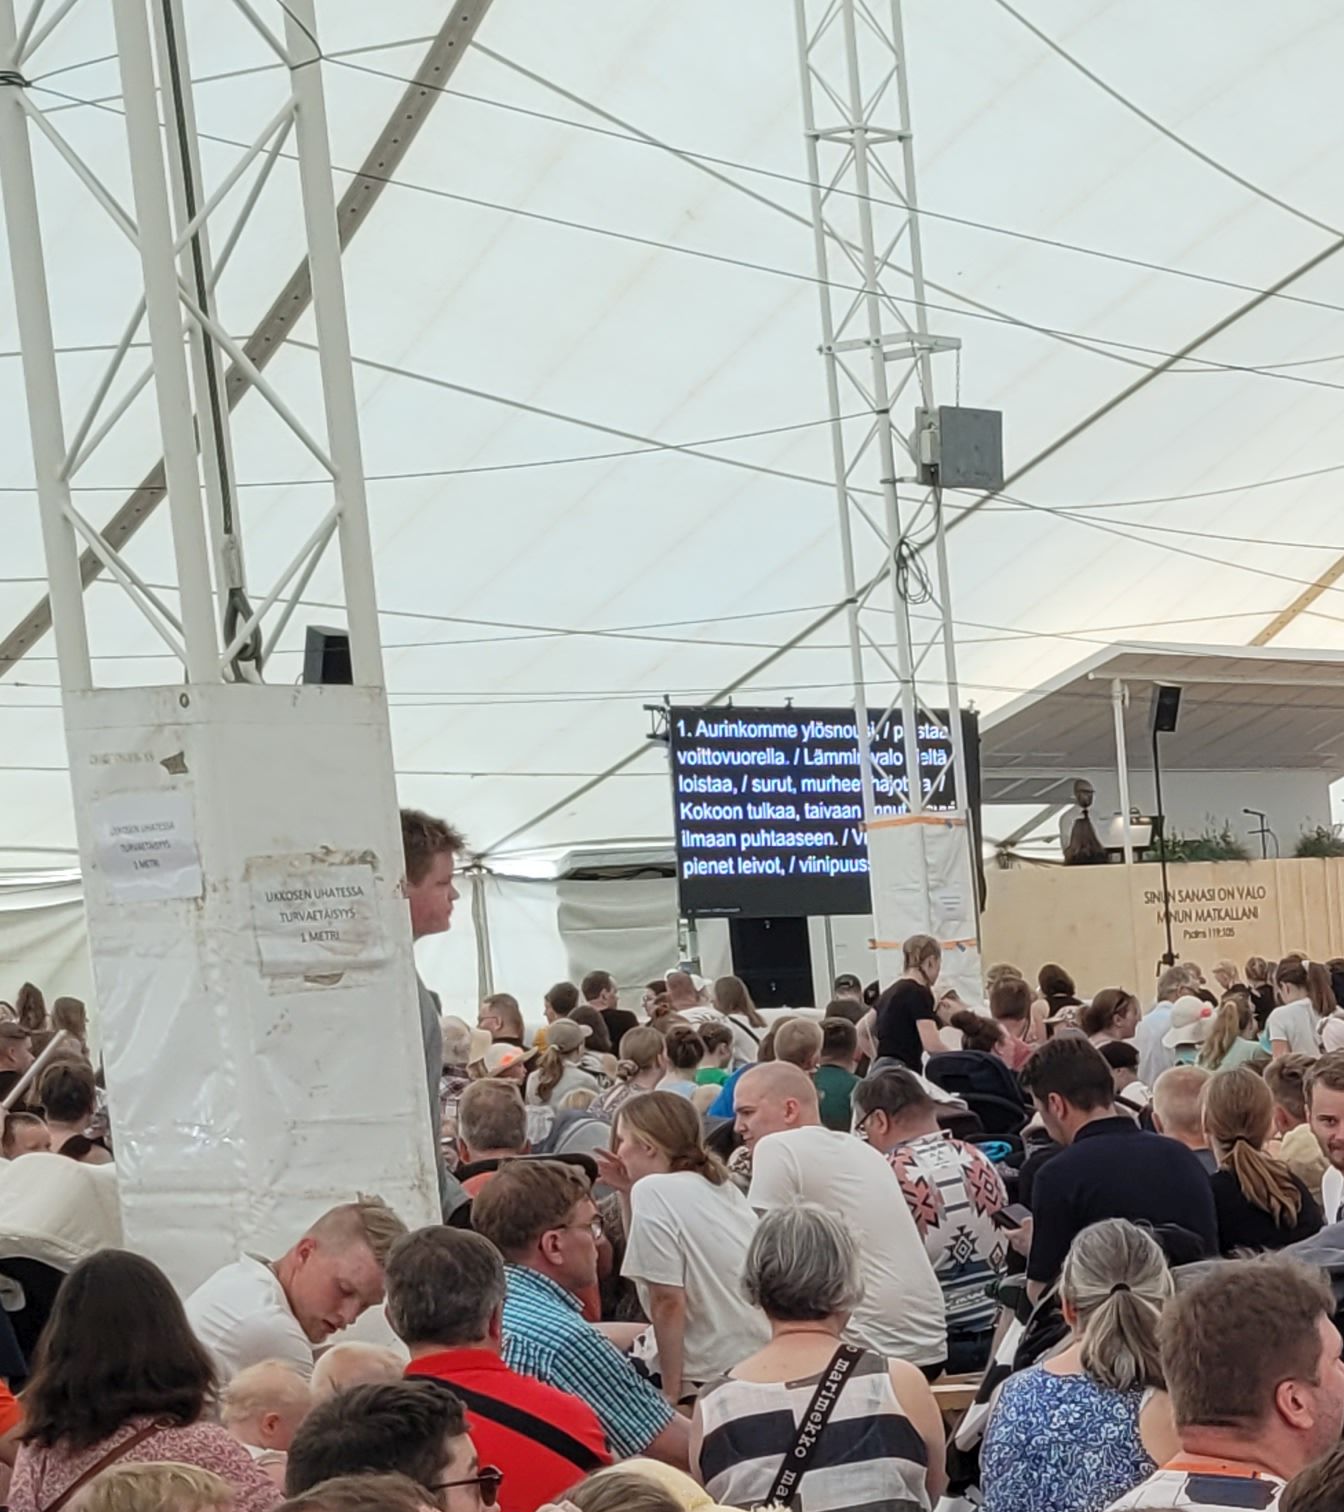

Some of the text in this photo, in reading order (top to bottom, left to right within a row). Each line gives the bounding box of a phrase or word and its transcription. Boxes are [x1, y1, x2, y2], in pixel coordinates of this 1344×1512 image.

[677, 719, 692, 737] 1.
[695, 718, 798, 738] Aurinkomme
[801, 719, 880, 742] ylösnoui,
[893, 723, 950, 743] pstaa
[677, 747, 789, 765] voittovuorella.
[870, 749, 903, 766] valo
[678, 774, 738, 795] loistaa,
[751, 776, 797, 794] surut,
[801, 774, 862, 793] murhee
[680, 802, 743, 820] Kokoon
[747, 802, 800, 821] tulkaa,
[804, 801, 861, 819] taivaan
[681, 829, 737, 847] ilmaan
[740, 829, 839, 851] puhtaaseen.
[682, 856, 736, 880] pienet
[737, 856, 786, 877] leivot,
[265, 886, 364, 902] UKKOSEN UHATESSA
[1178, 888, 1216, 902] SANASI
[1217, 887, 1235, 901] ON
[1236, 886, 1266, 900] VALO
[1157, 906, 1259, 923] MNUN MATKALLANI
[309, 930, 340, 941] METRI
[794, 1357, 850, 1458] marimekko
